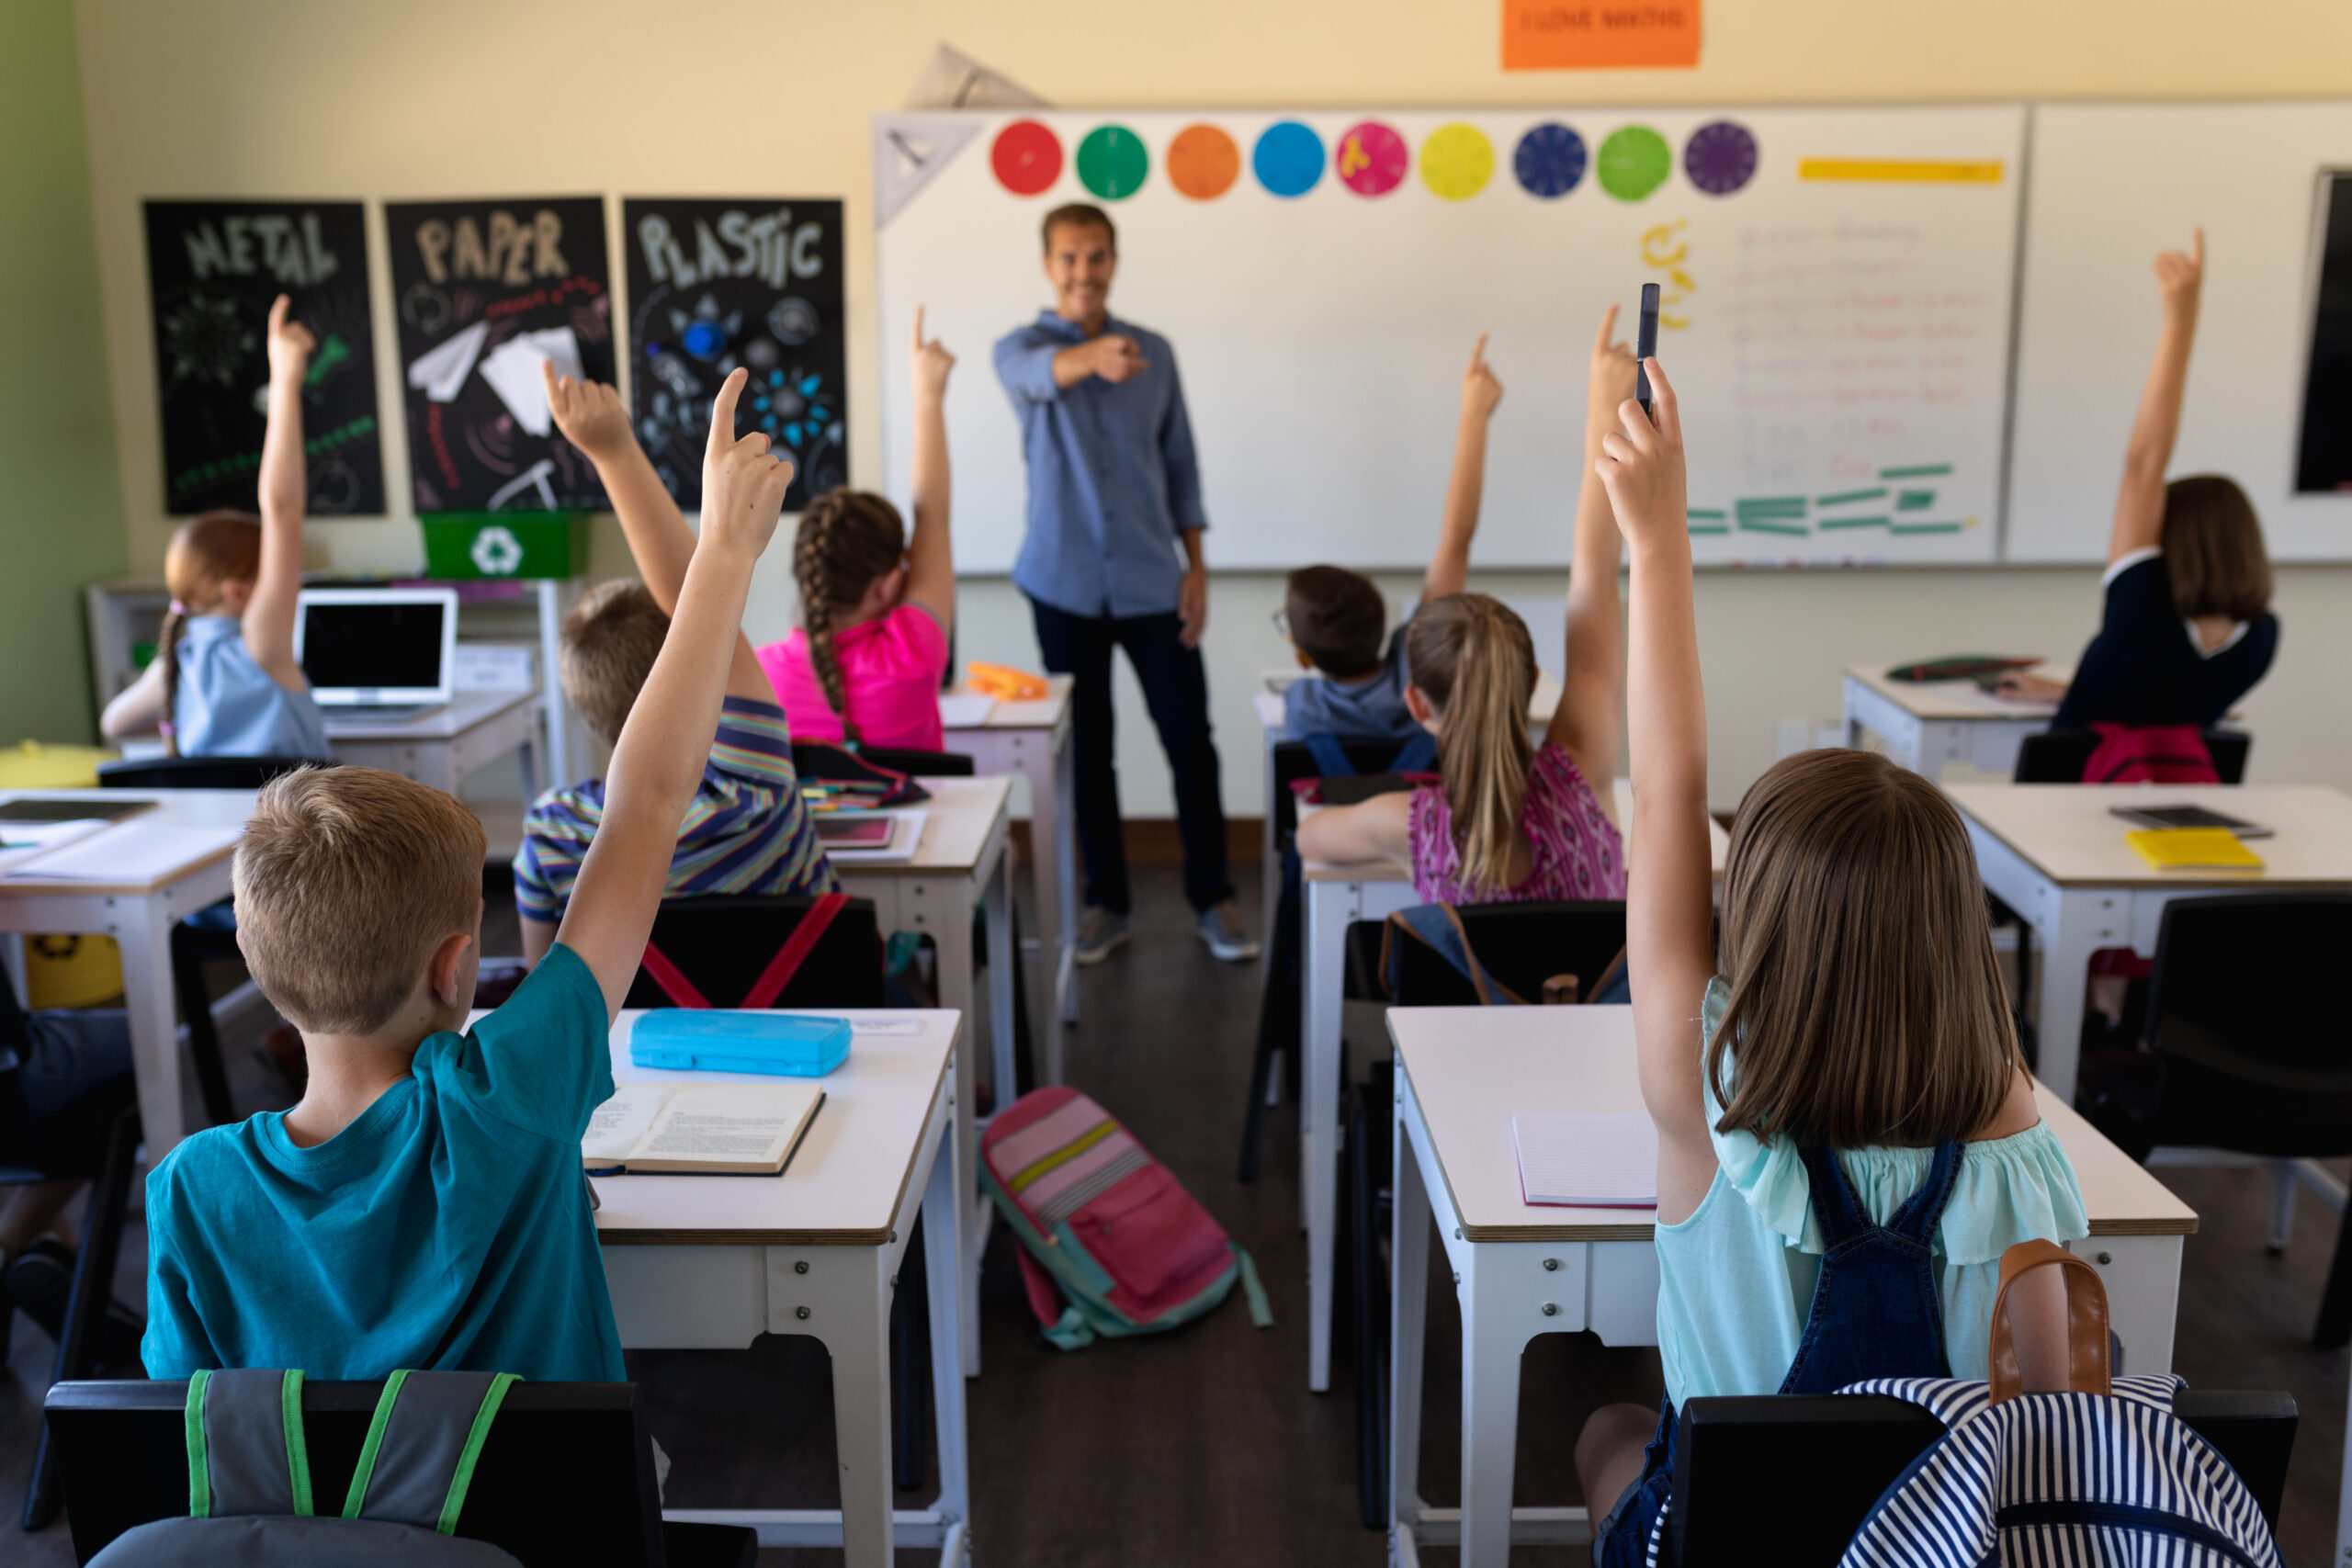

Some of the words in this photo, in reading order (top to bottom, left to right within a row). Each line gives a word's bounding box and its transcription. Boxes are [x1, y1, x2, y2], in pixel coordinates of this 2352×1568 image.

[1535, 6, 1593, 34] LOVE
[1600, 5, 1687, 32] MATHS
[183, 212, 338, 286] METAL
[416, 209, 571, 287] PAPER
